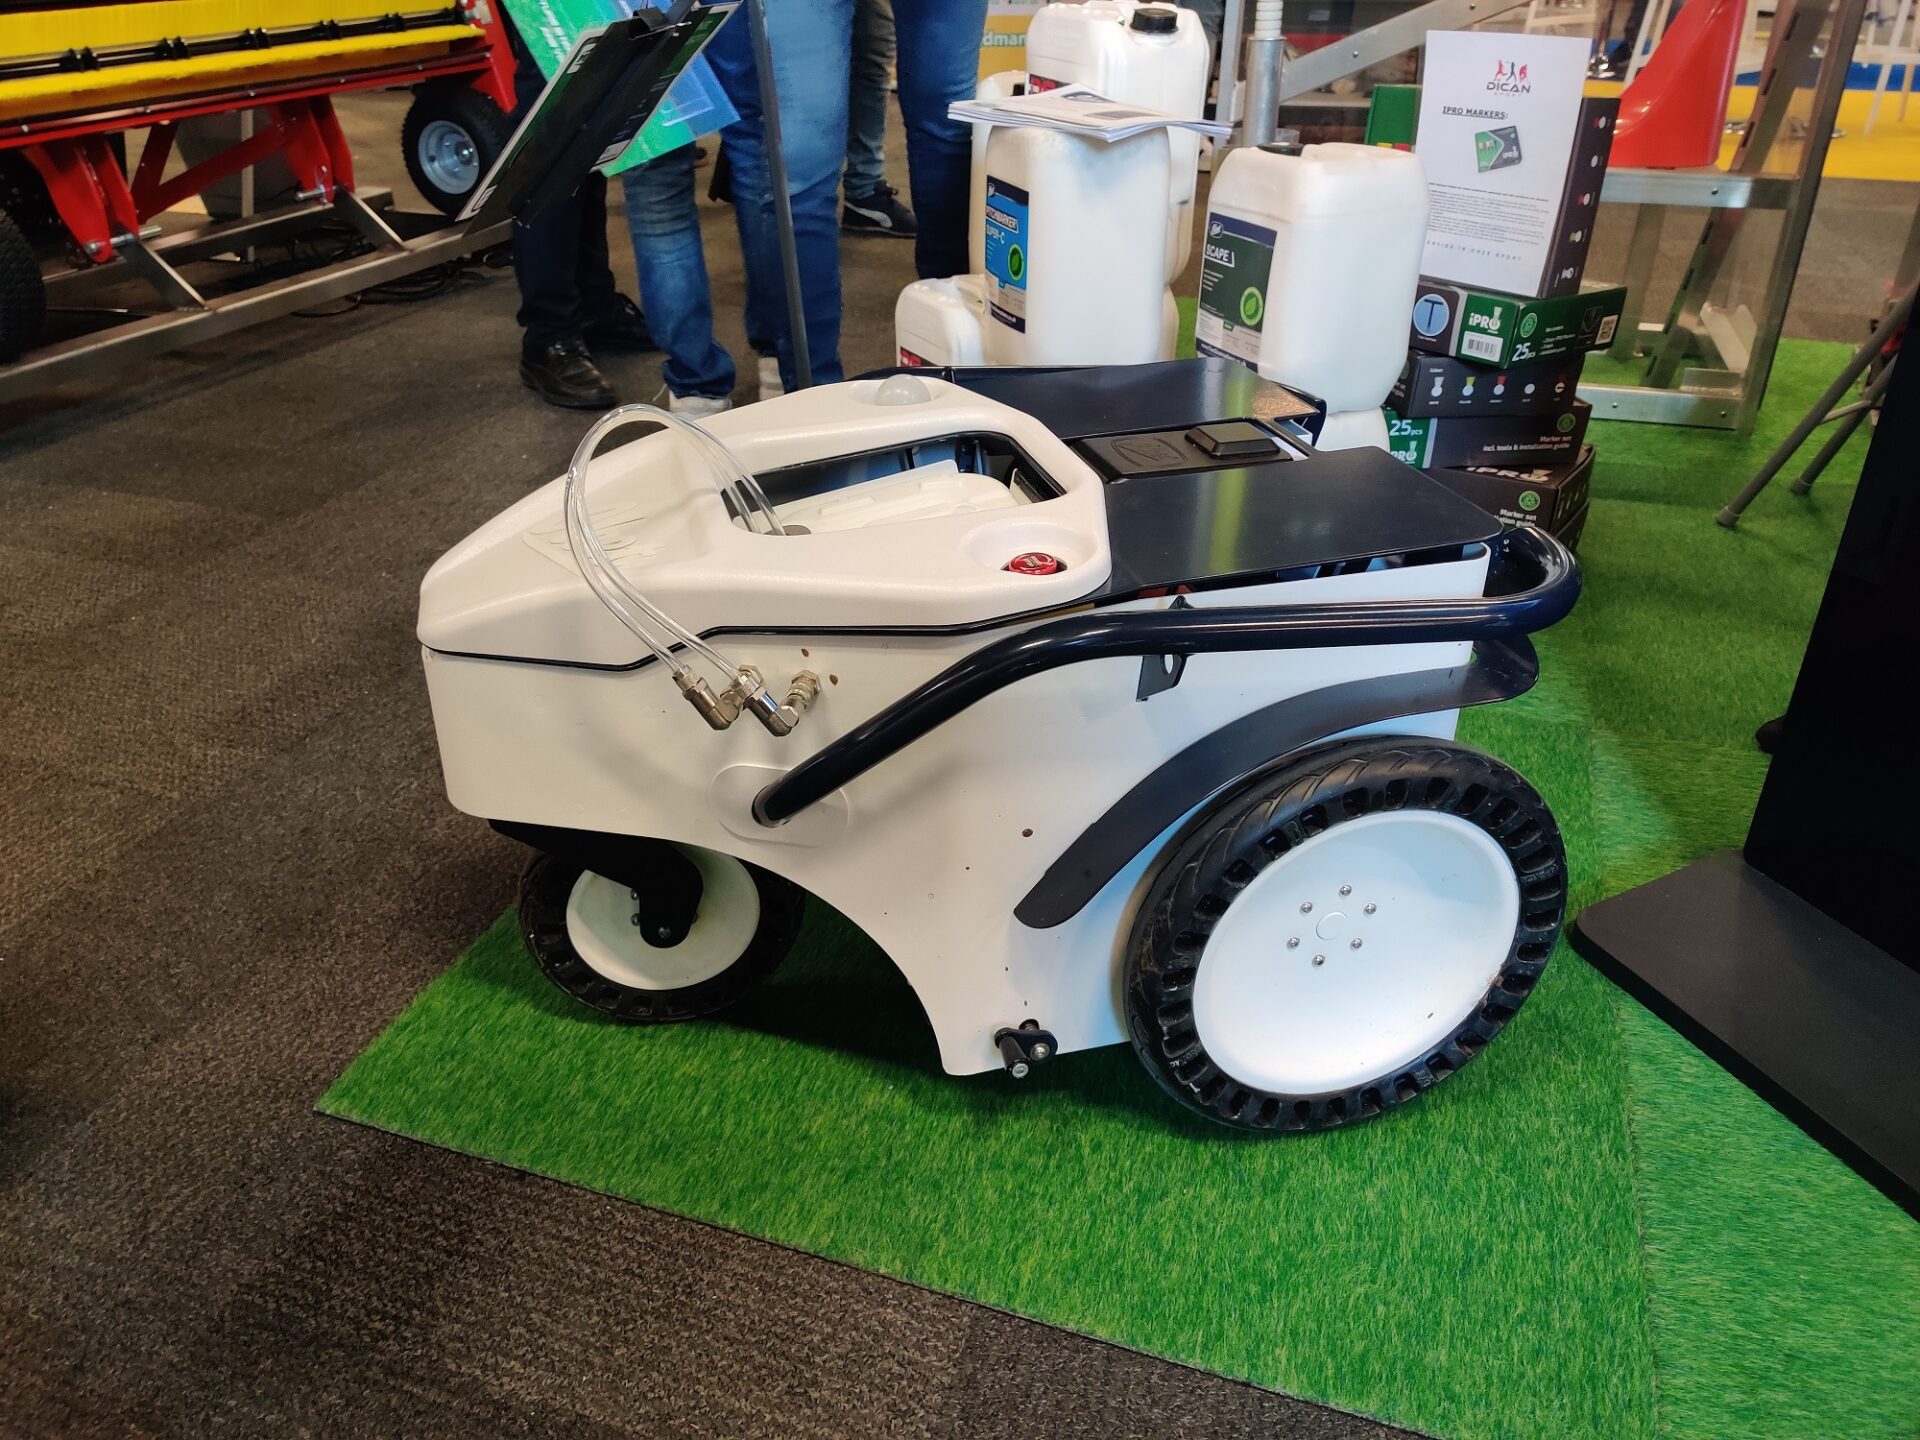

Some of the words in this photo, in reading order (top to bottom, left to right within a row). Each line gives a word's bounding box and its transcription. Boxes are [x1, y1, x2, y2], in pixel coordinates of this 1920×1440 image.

[1486, 81, 1531, 93] DICAN
[1465, 108, 1508, 120] MARKERS:
[1500, 508, 1524, 519] Marker
